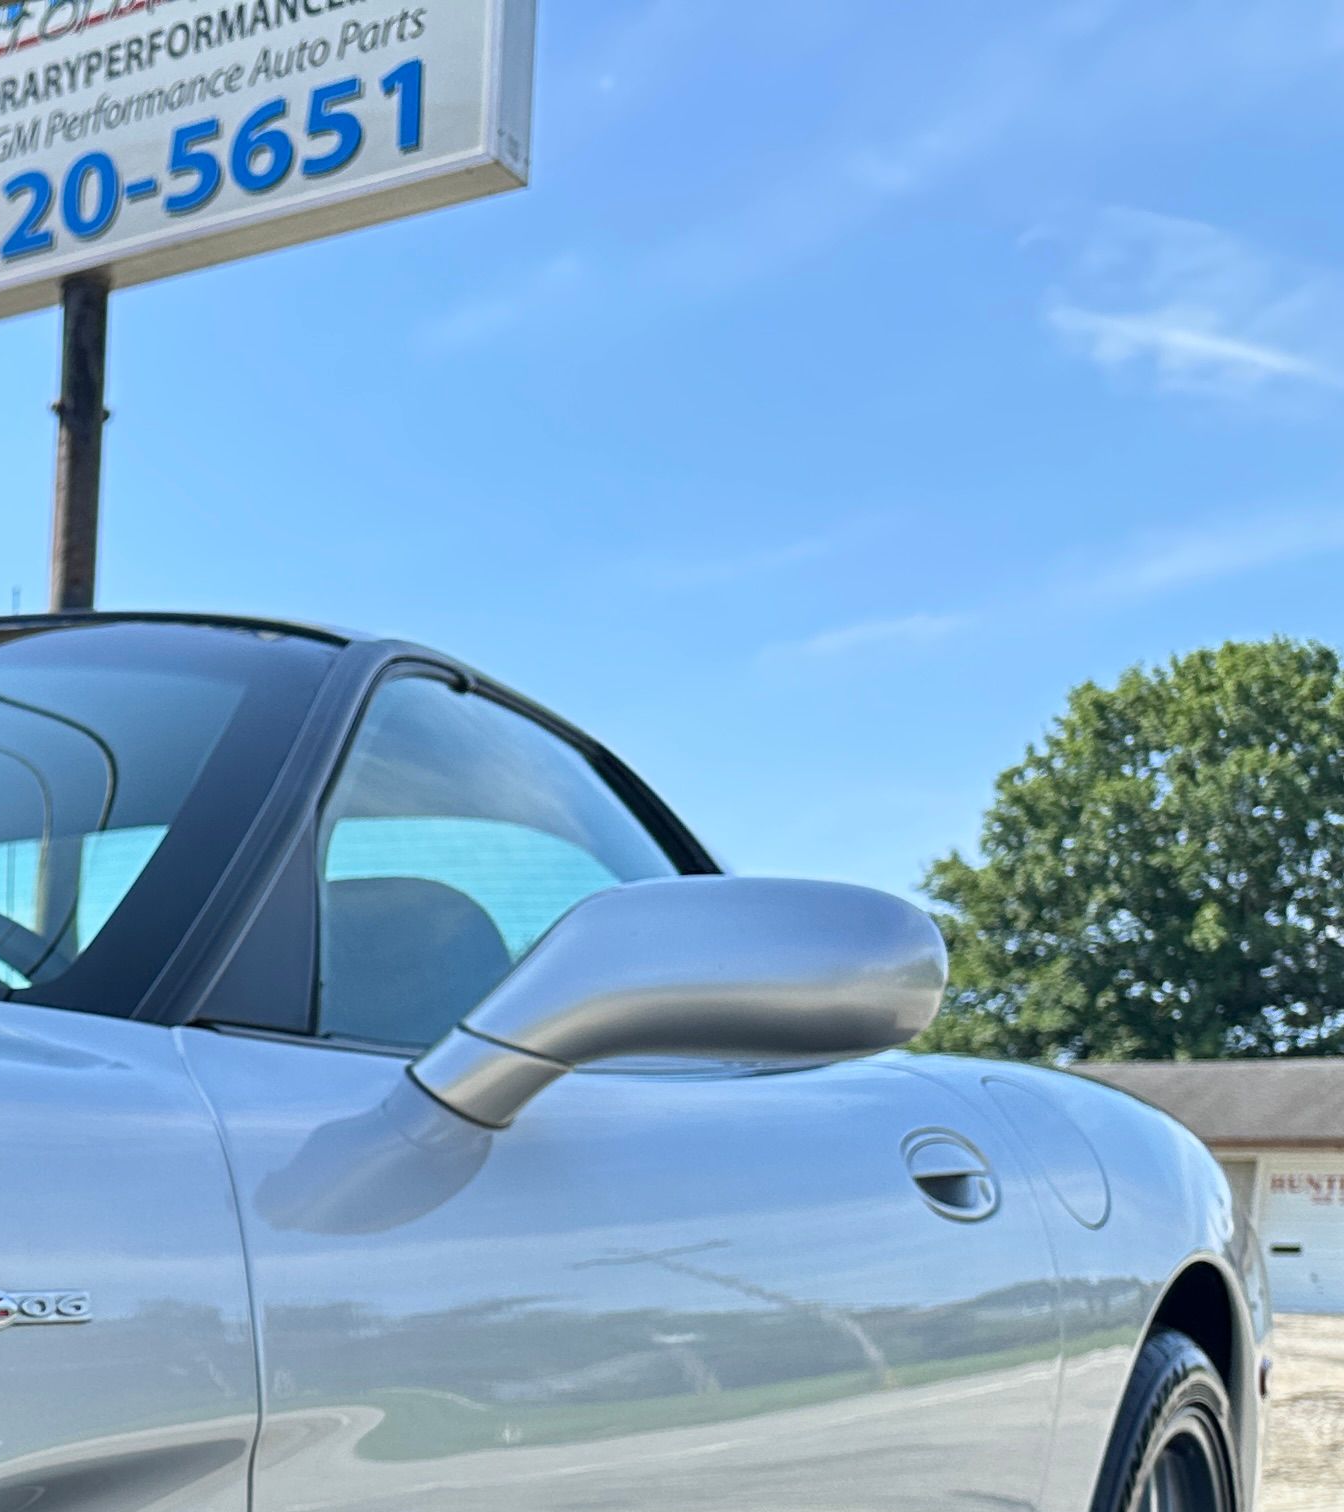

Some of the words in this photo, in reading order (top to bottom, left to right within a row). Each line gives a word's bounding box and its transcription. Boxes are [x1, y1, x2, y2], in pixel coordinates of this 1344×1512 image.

[43, 63, 245, 148] Performance
[248, 37, 330, 88] Auto
[336, 6, 427, 60] Parts
